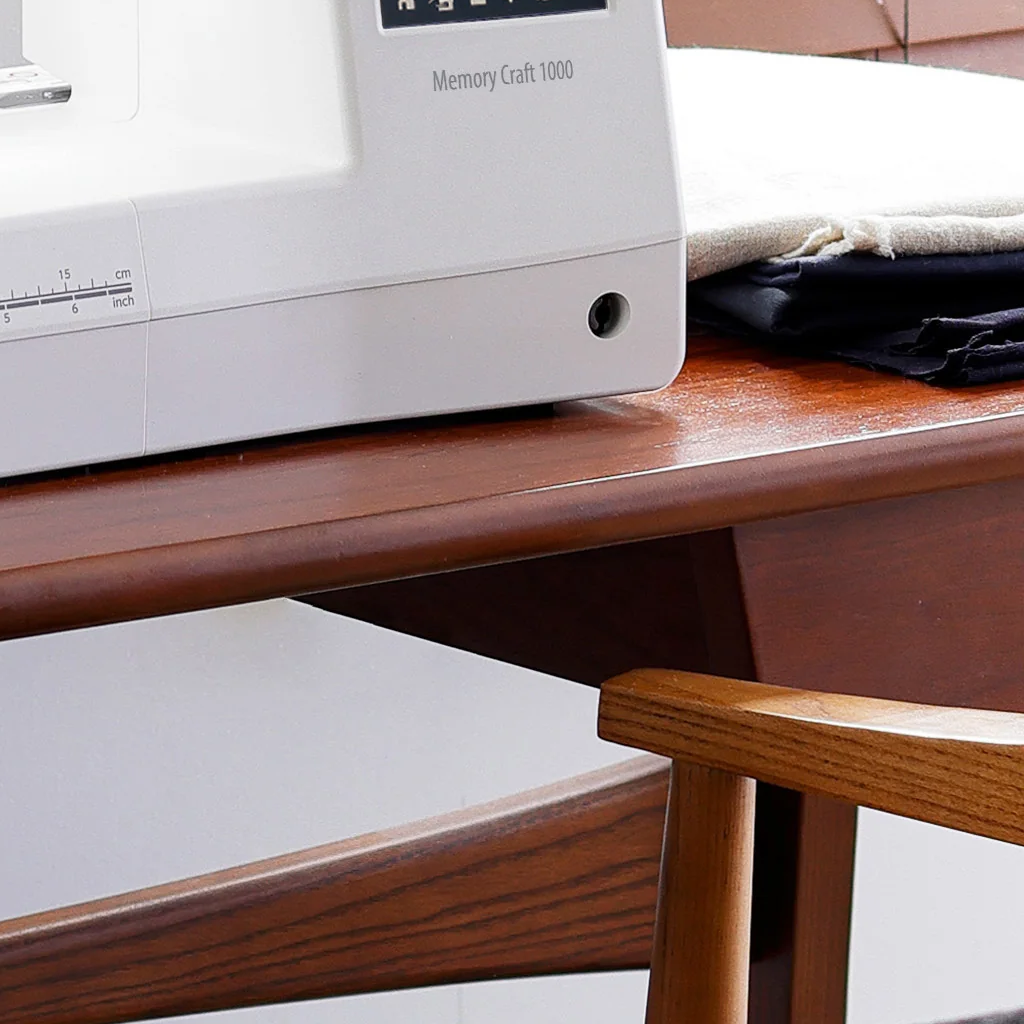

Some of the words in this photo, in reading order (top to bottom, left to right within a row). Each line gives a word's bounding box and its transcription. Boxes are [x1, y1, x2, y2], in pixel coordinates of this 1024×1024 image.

[433, 69, 496, 93] Memory
[501, 62, 536, 87] Craft
[540, 59, 574, 82] 1000
[58, 268, 71, 280] 15
[115, 269, 132, 280] cm
[4, 313, 11, 324] 5
[72, 303, 79, 314] 6
[112, 293, 134, 308] inch
